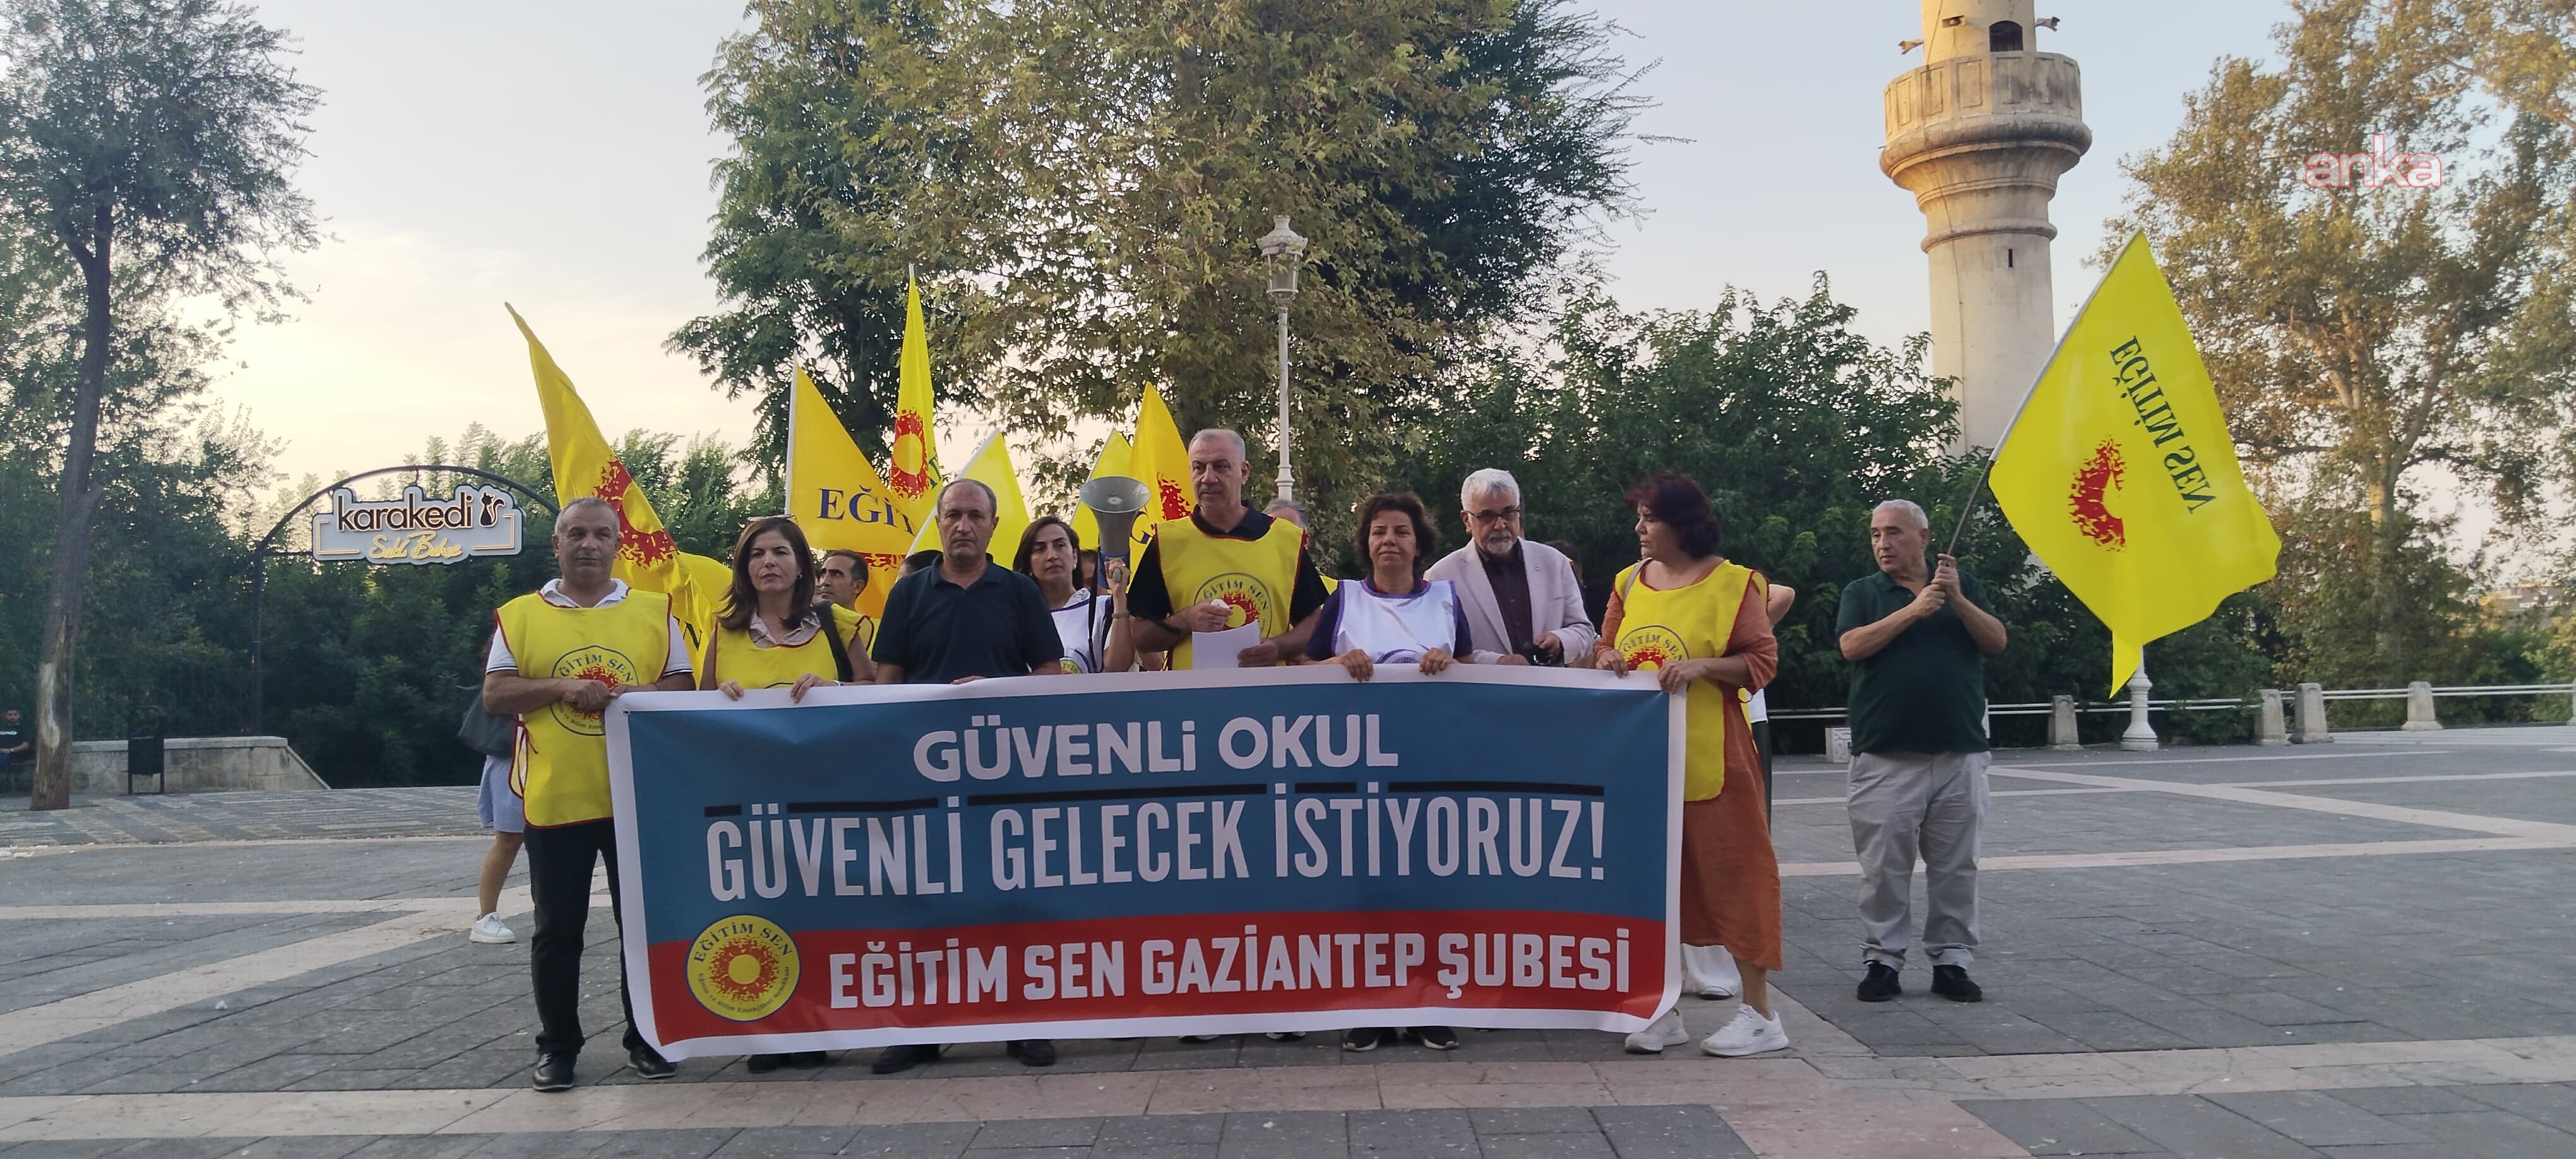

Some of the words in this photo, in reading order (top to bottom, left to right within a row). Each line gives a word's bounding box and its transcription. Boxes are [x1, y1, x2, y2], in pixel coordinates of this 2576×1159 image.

[337, 492, 473, 532] karakedi
[557, 653, 602, 677] ĞİTİM
[607, 658, 634, 682] SEN
[1218, 713, 1399, 770] OKUL
[706, 795, 963, 901] GÜVENLİ
[990, 800, 1249, 891] GELECEK
[1274, 782, 1605, 881] İSTİYORUZ!
[693, 922, 754, 963] EĞİTİM
[760, 927, 792, 956] SEN
[830, 937, 1008, 1009] EĞİTİM
[1023, 942, 1125, 1001] SEN
[1141, 924, 1425, 996] GAZİANTEP
[1437, 927, 1630, 999] ŞUBESİ
